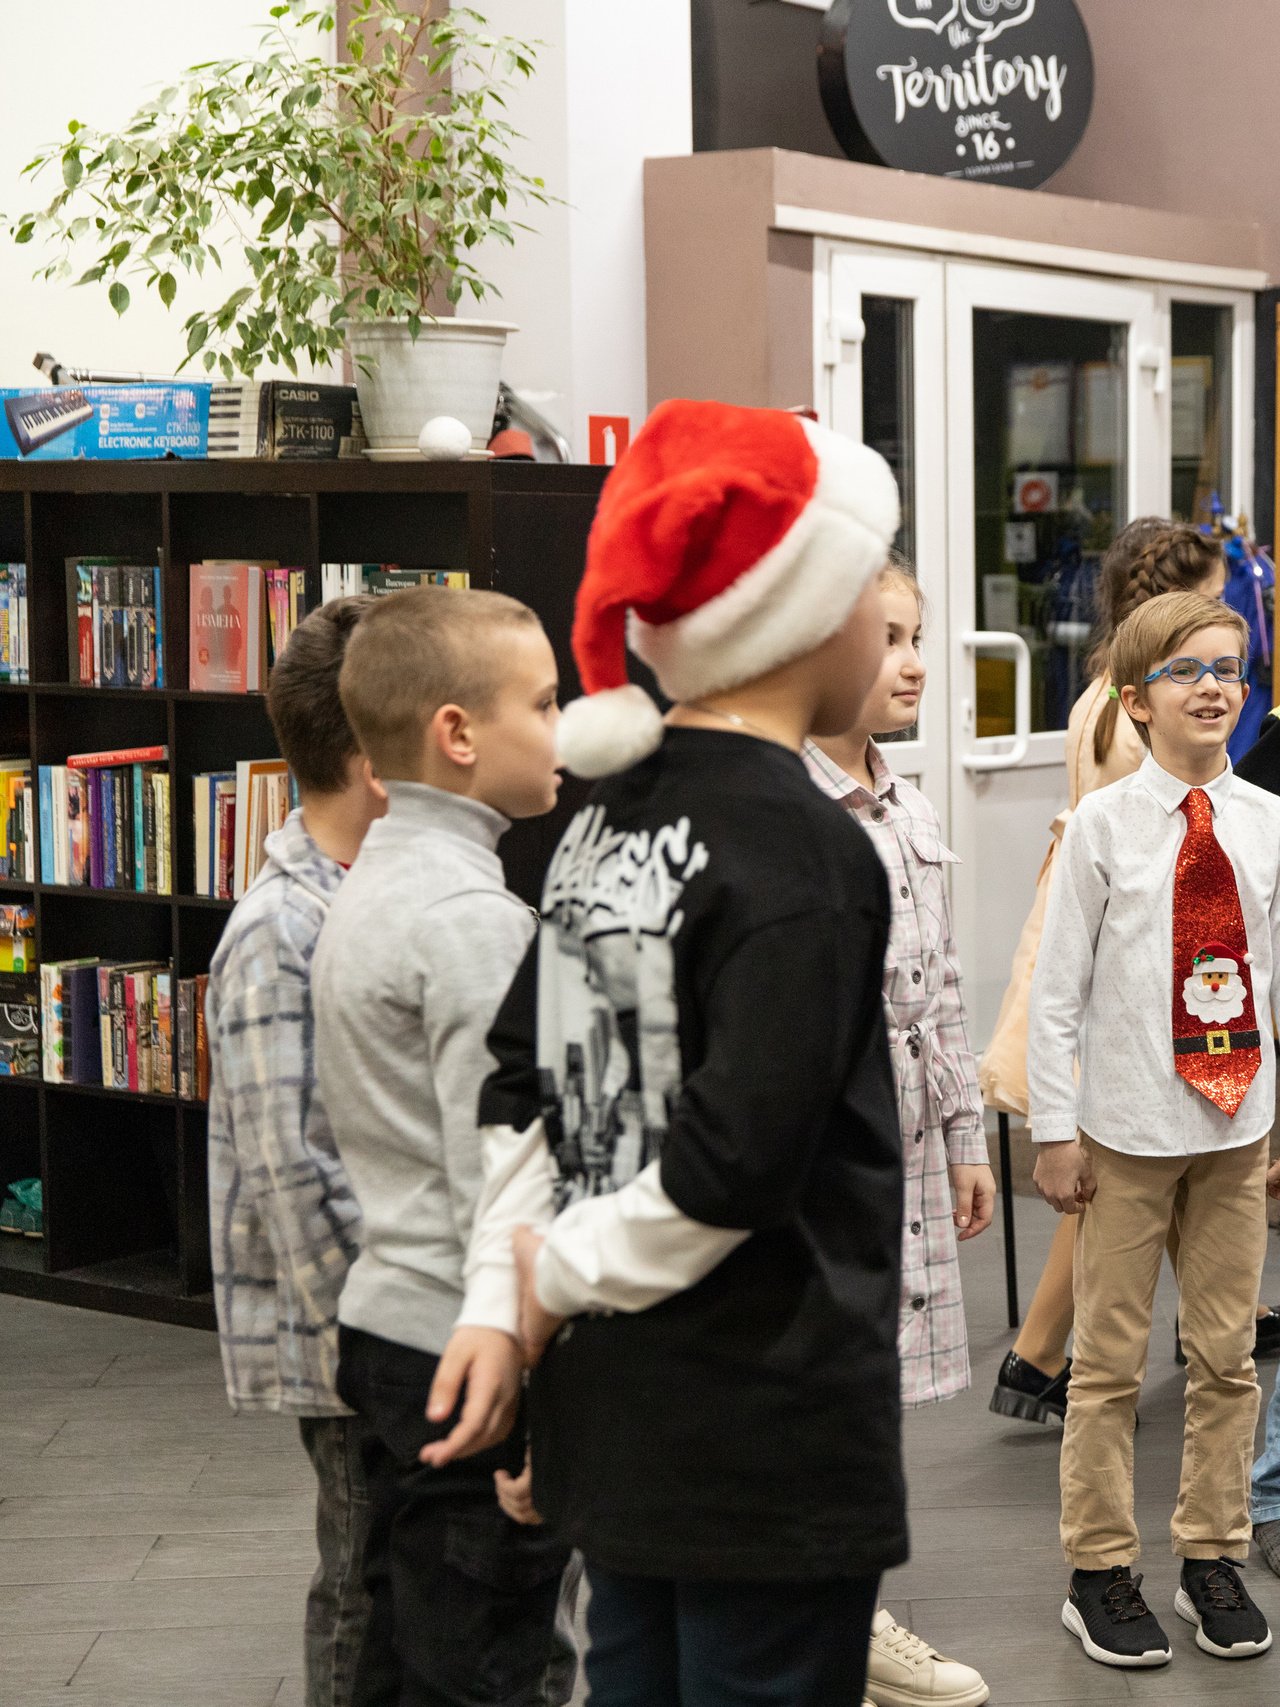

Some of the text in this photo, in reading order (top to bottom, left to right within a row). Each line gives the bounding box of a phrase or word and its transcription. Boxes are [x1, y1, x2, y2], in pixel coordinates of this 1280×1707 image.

[876, 43, 1067, 123] Territory
[954, 111, 1012, 138] SINCE
[971, 130, 1001, 162] 16
[279, 389, 320, 402] CASIO
[166, 421, 201, 433] CTK-1100
[281, 423, 335, 441] CTK-1100
[98, 435, 200, 449] ELECTRONIC KEYBOARD
